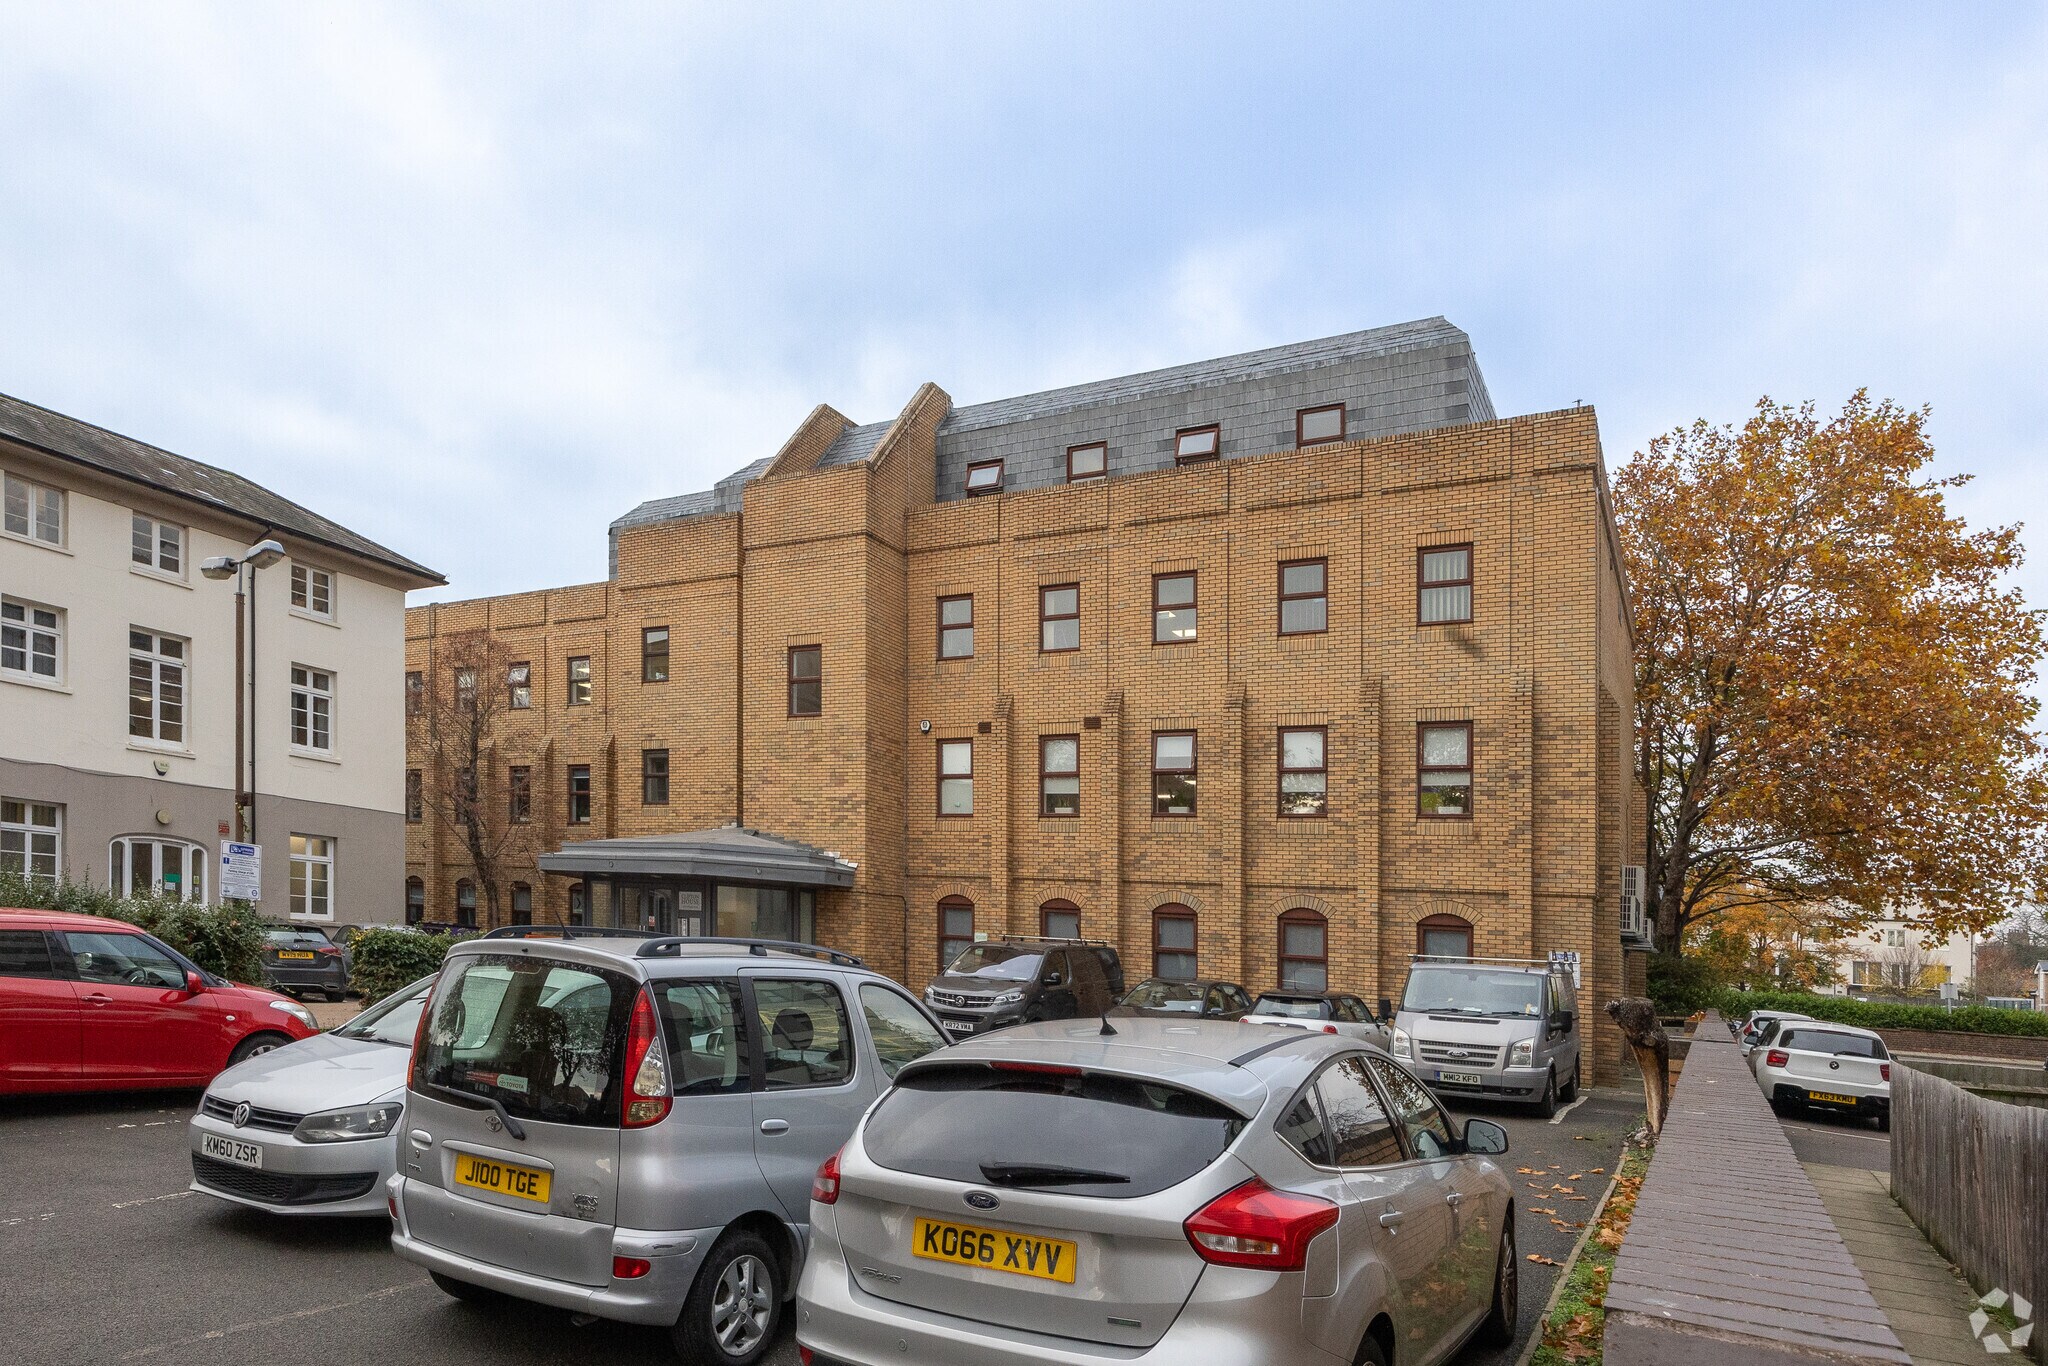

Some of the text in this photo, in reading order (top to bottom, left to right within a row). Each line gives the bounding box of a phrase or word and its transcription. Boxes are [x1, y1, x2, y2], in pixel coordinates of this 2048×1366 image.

[506, 1081, 524, 1089] TOYOTA
[1462, 1075, 1478, 1083] KFO
[1813, 1091, 1835, 1100] FX63
[206, 1136, 258, 1164] KM60 ZSR
[465, 1161, 539, 1196] J100 TGE
[970, 1193, 992, 1208] Ford
[923, 1223, 1062, 1275] KO66 XVV
